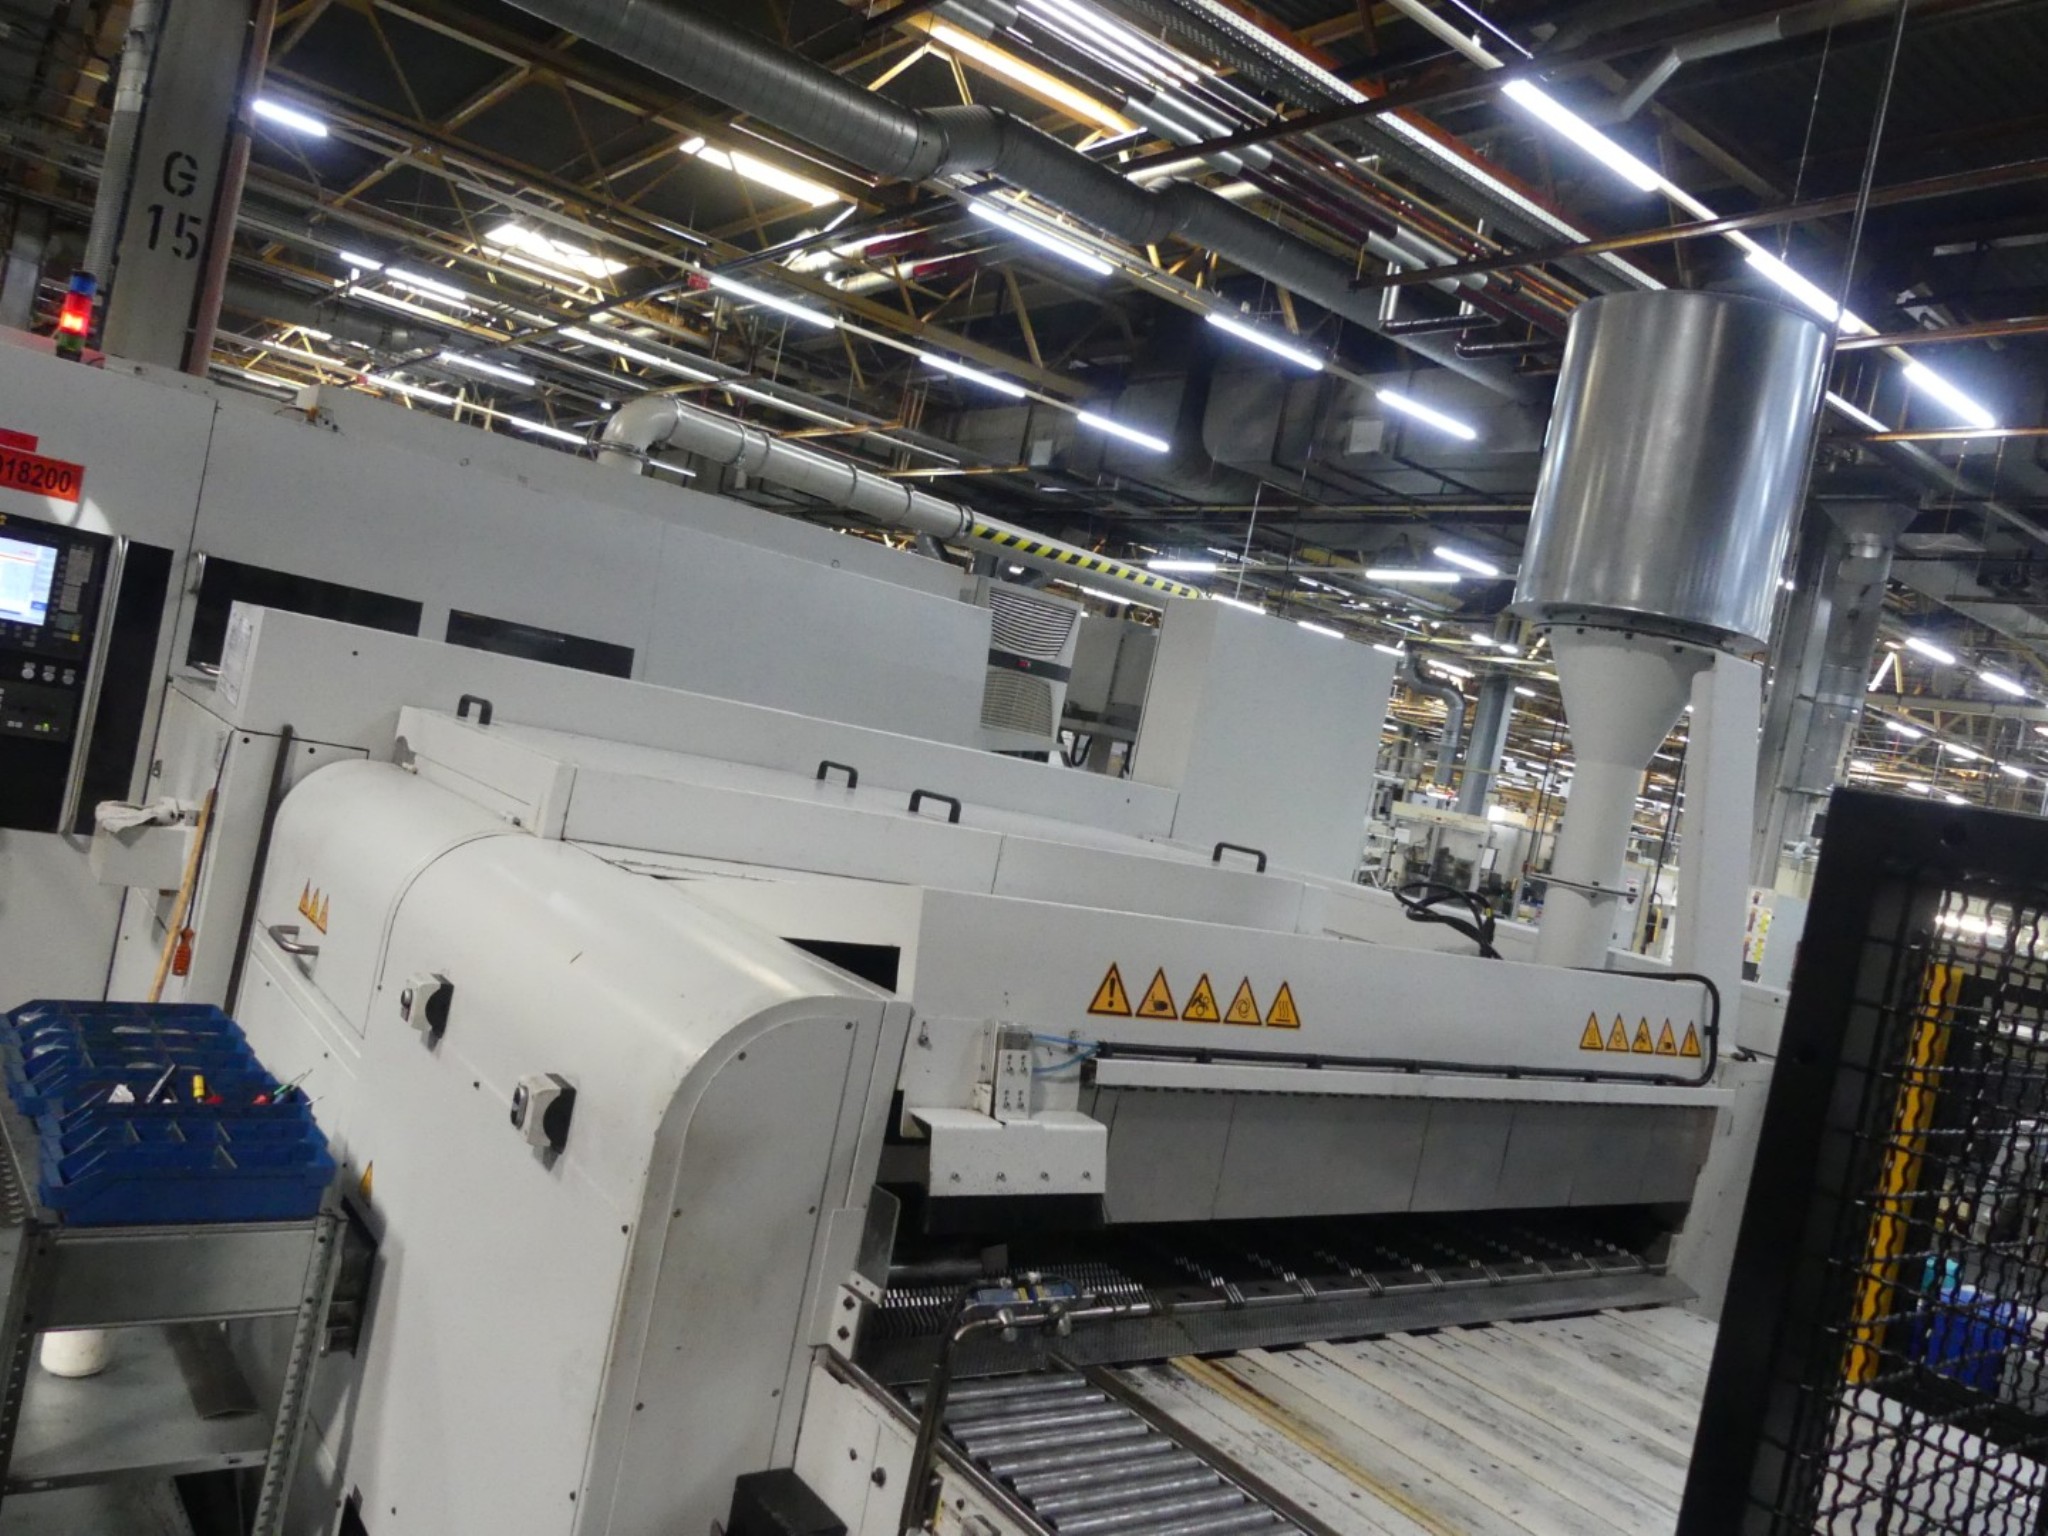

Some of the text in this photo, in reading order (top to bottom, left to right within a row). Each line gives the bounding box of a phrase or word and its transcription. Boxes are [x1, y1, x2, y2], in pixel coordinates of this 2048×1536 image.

[163, 151, 198, 197] G
[148, 204, 202, 260] 15
[0, 455, 71, 493] 18200
